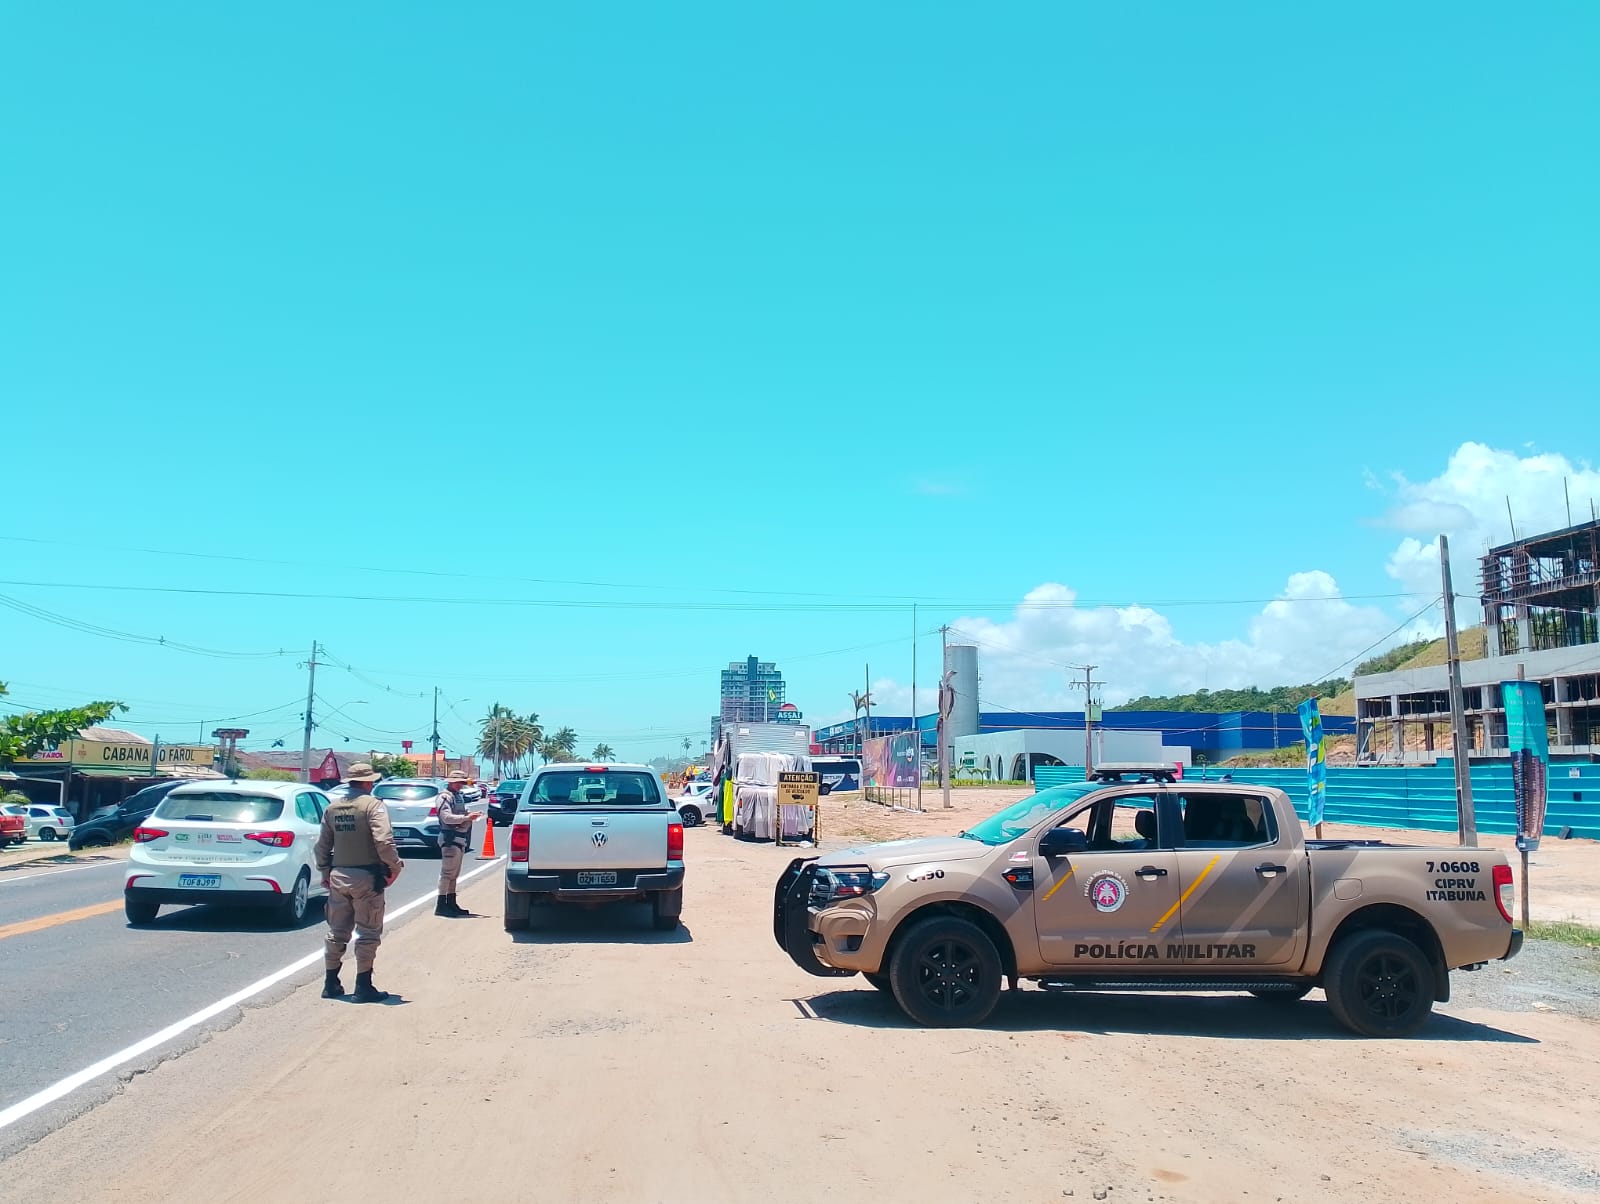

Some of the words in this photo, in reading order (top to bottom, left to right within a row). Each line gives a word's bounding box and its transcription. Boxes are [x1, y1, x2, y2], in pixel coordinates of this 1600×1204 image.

[103, 746, 149, 761] CABANA
[168, 748, 194, 762] FAROL
[1426, 861, 1480, 873] 7.0608
[1434, 878, 1476, 889] CIPRV
[1426, 890, 1486, 901] ITABUNA
[1074, 940, 1159, 959] POLÍCIA
[1166, 944, 1256, 959] MILITAR
